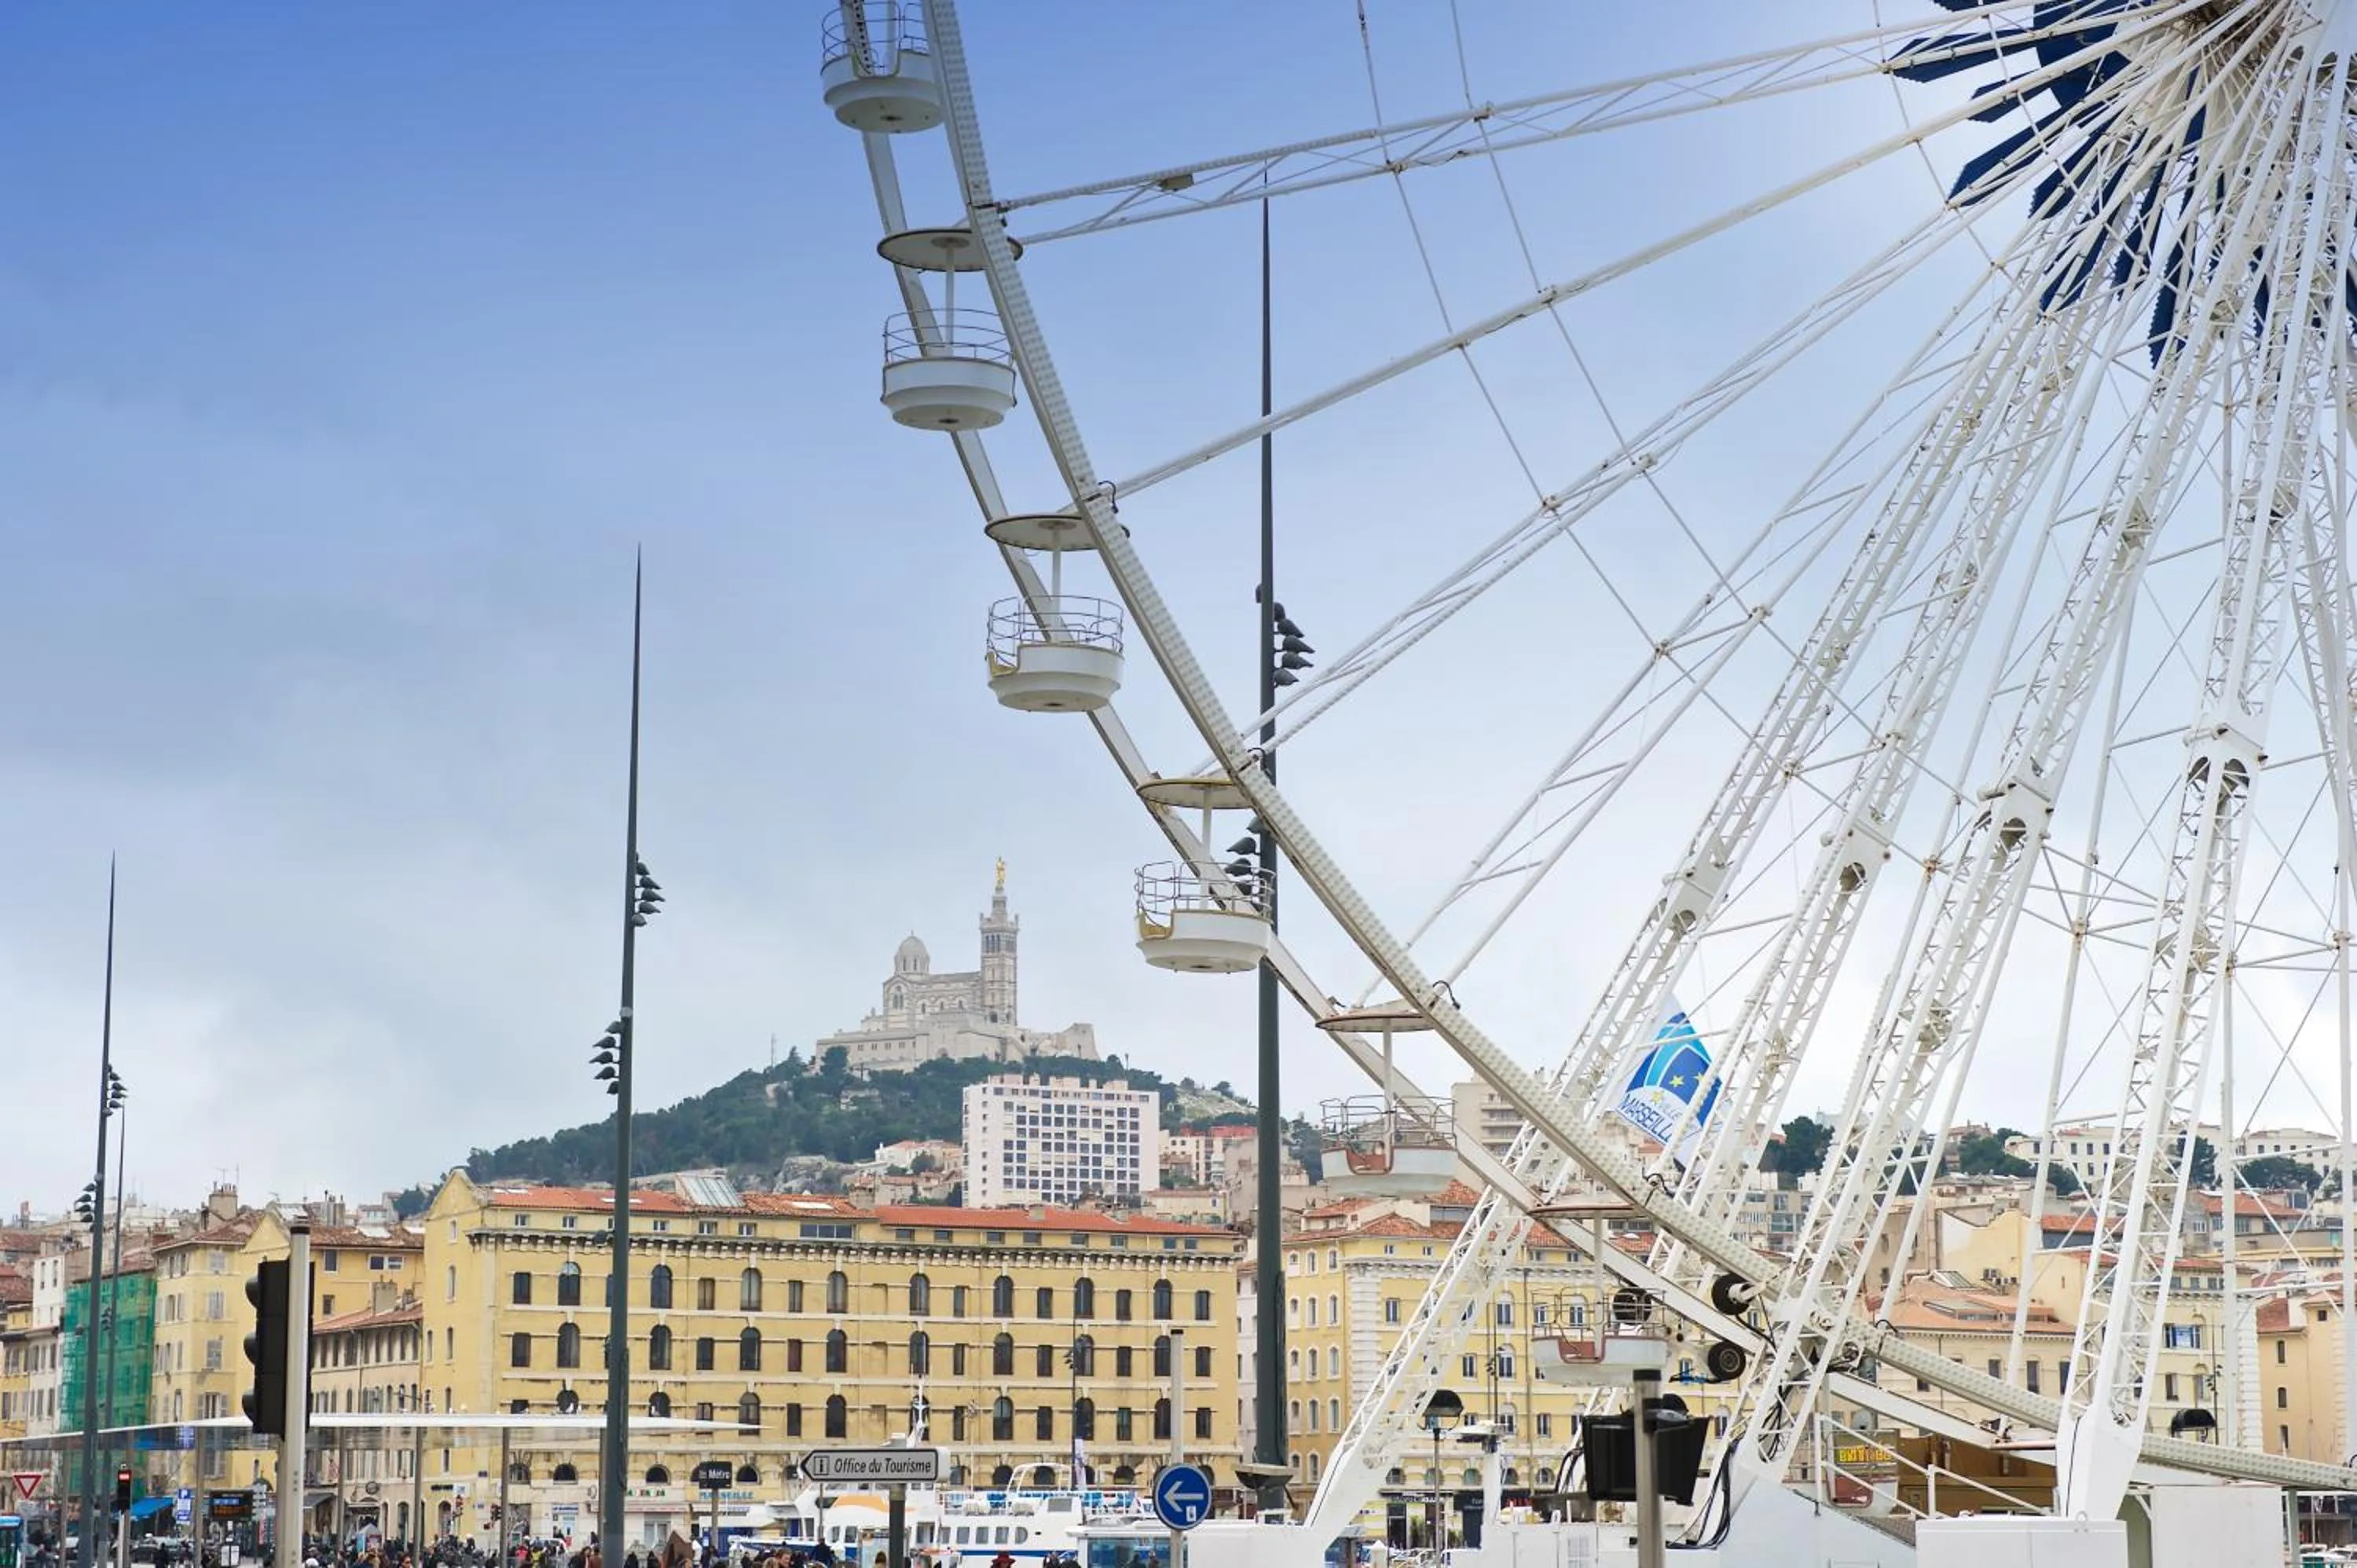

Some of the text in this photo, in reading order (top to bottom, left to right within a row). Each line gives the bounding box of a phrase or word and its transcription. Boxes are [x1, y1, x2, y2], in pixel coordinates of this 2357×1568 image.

[1620, 1093, 1673, 1143] MARSEILL
[834, 1457, 865, 1473] Office
[868, 1458, 882, 1473] du
[885, 1457, 931, 1473] Tourisme
